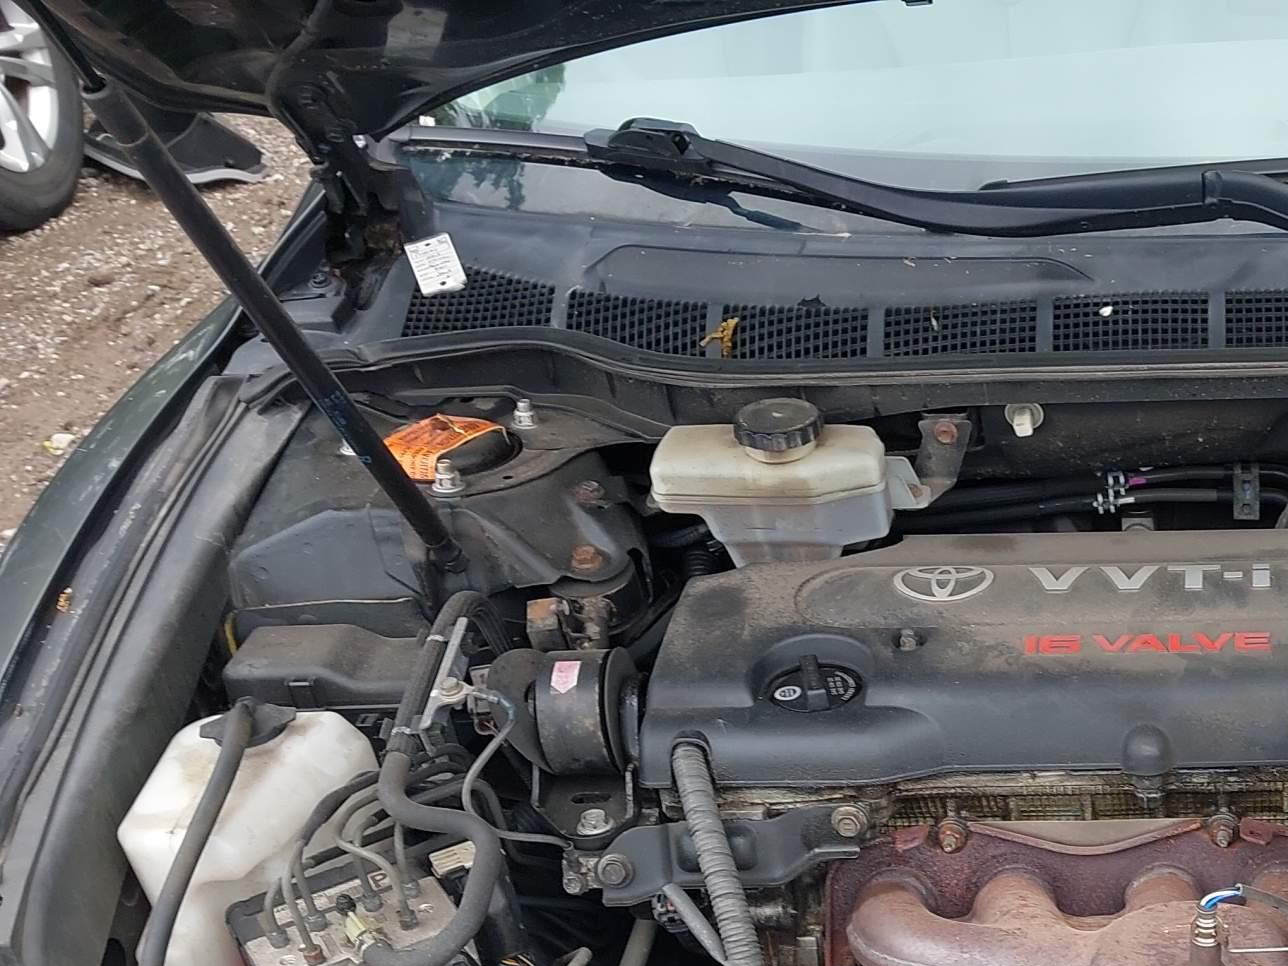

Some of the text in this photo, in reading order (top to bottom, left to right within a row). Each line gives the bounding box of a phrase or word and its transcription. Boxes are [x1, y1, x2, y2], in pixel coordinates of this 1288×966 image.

[1029, 564, 1271, 591] VVT-i
[1025, 632, 1271, 654] 16 VALVE
